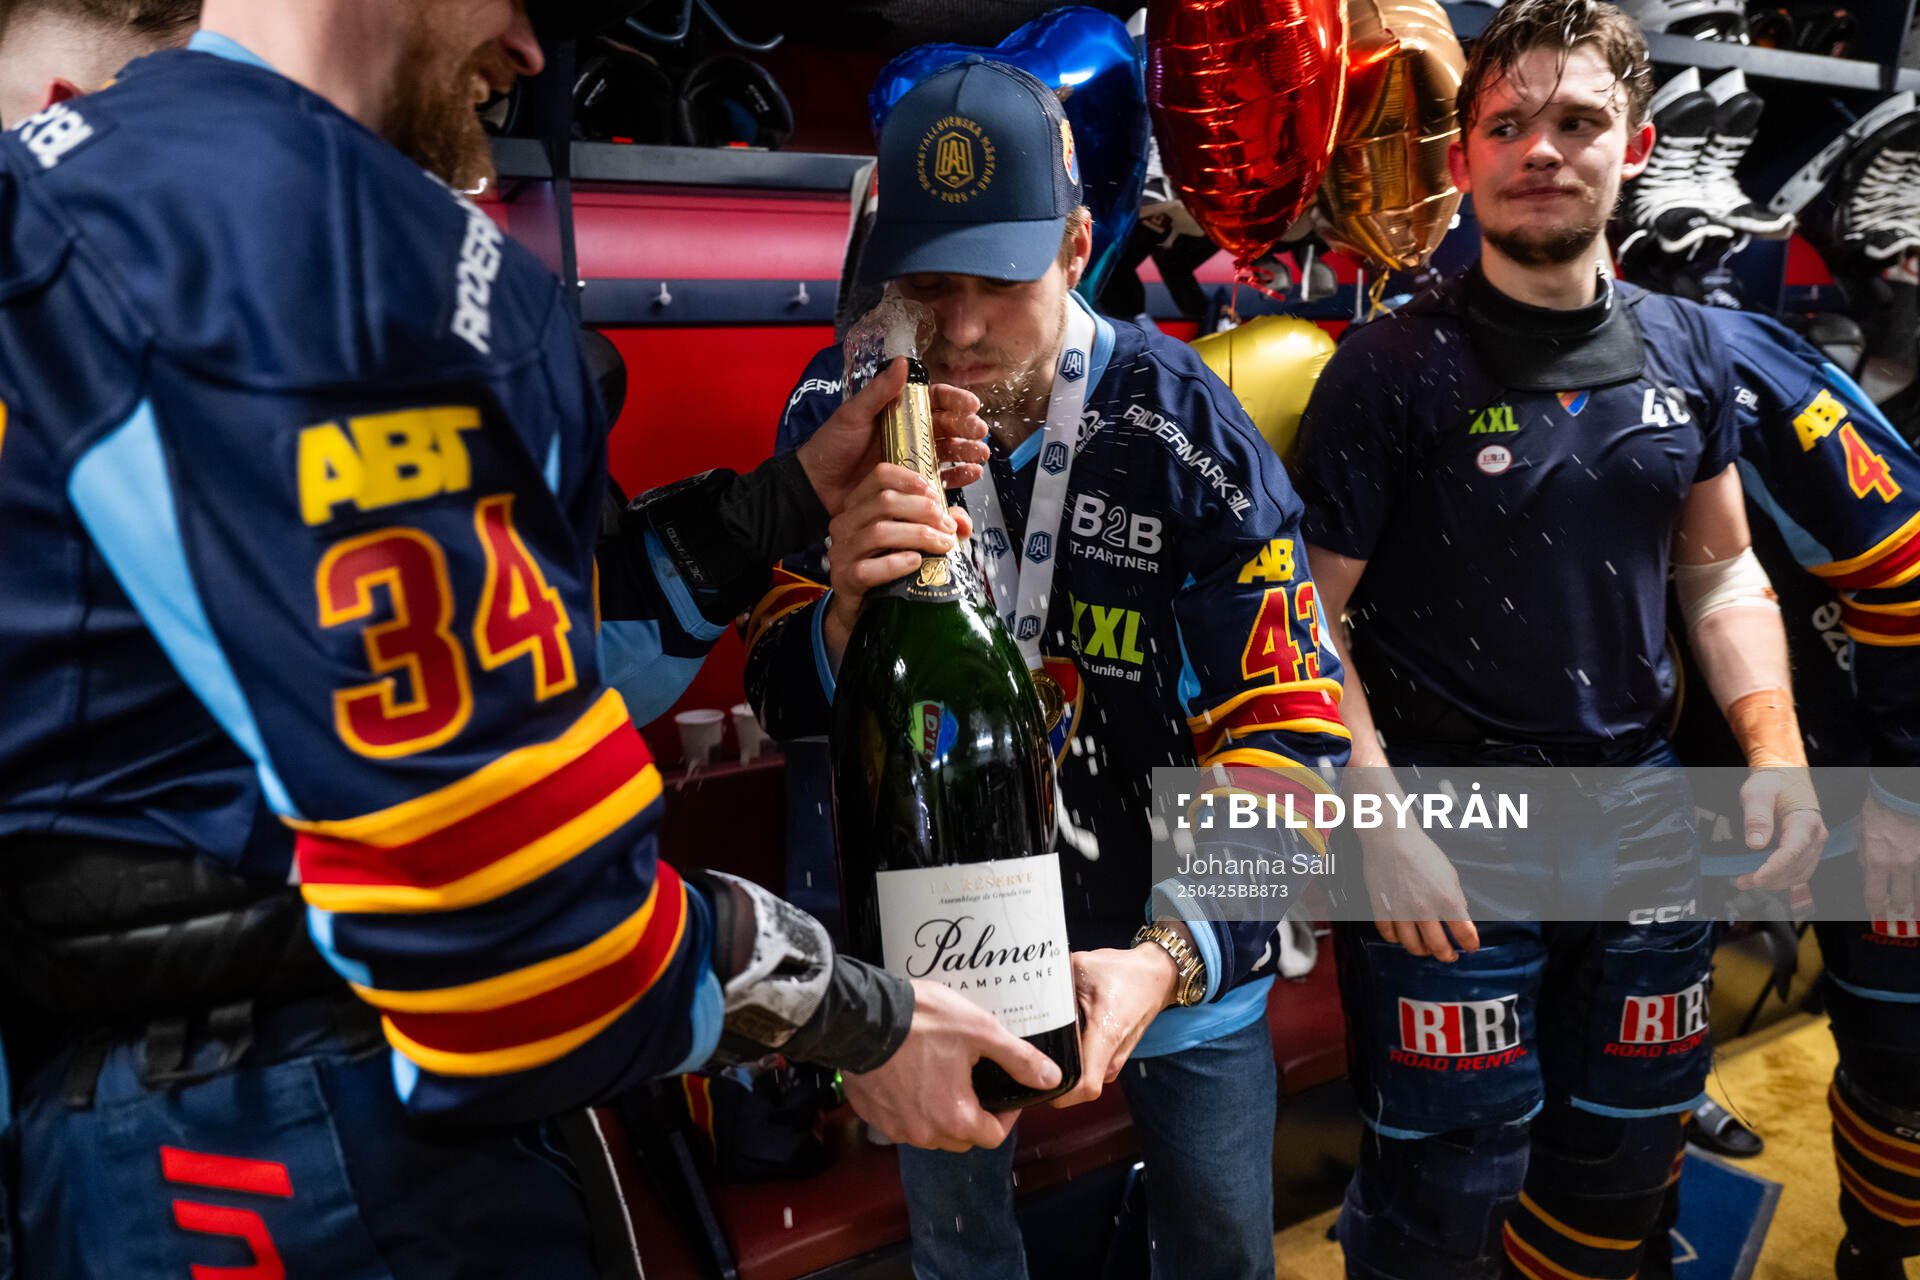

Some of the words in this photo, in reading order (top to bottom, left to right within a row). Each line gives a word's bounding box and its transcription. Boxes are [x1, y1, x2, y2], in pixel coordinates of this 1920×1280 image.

[1468, 405, 1519, 434] XXL
[297, 406, 481, 525] ABT
[1071, 493, 1162, 555] B2B
[1237, 539, 1295, 584] AB
[315, 493, 577, 759] 34
[1069, 591, 1144, 665] XXL
[1091, 664, 1124, 678] unite
[1125, 670, 1141, 682] all
[906, 915, 1052, 978] Palmer
[1388, 1049, 1449, 1072] ROAD
[1603, 1041, 1663, 1058] ROAD
